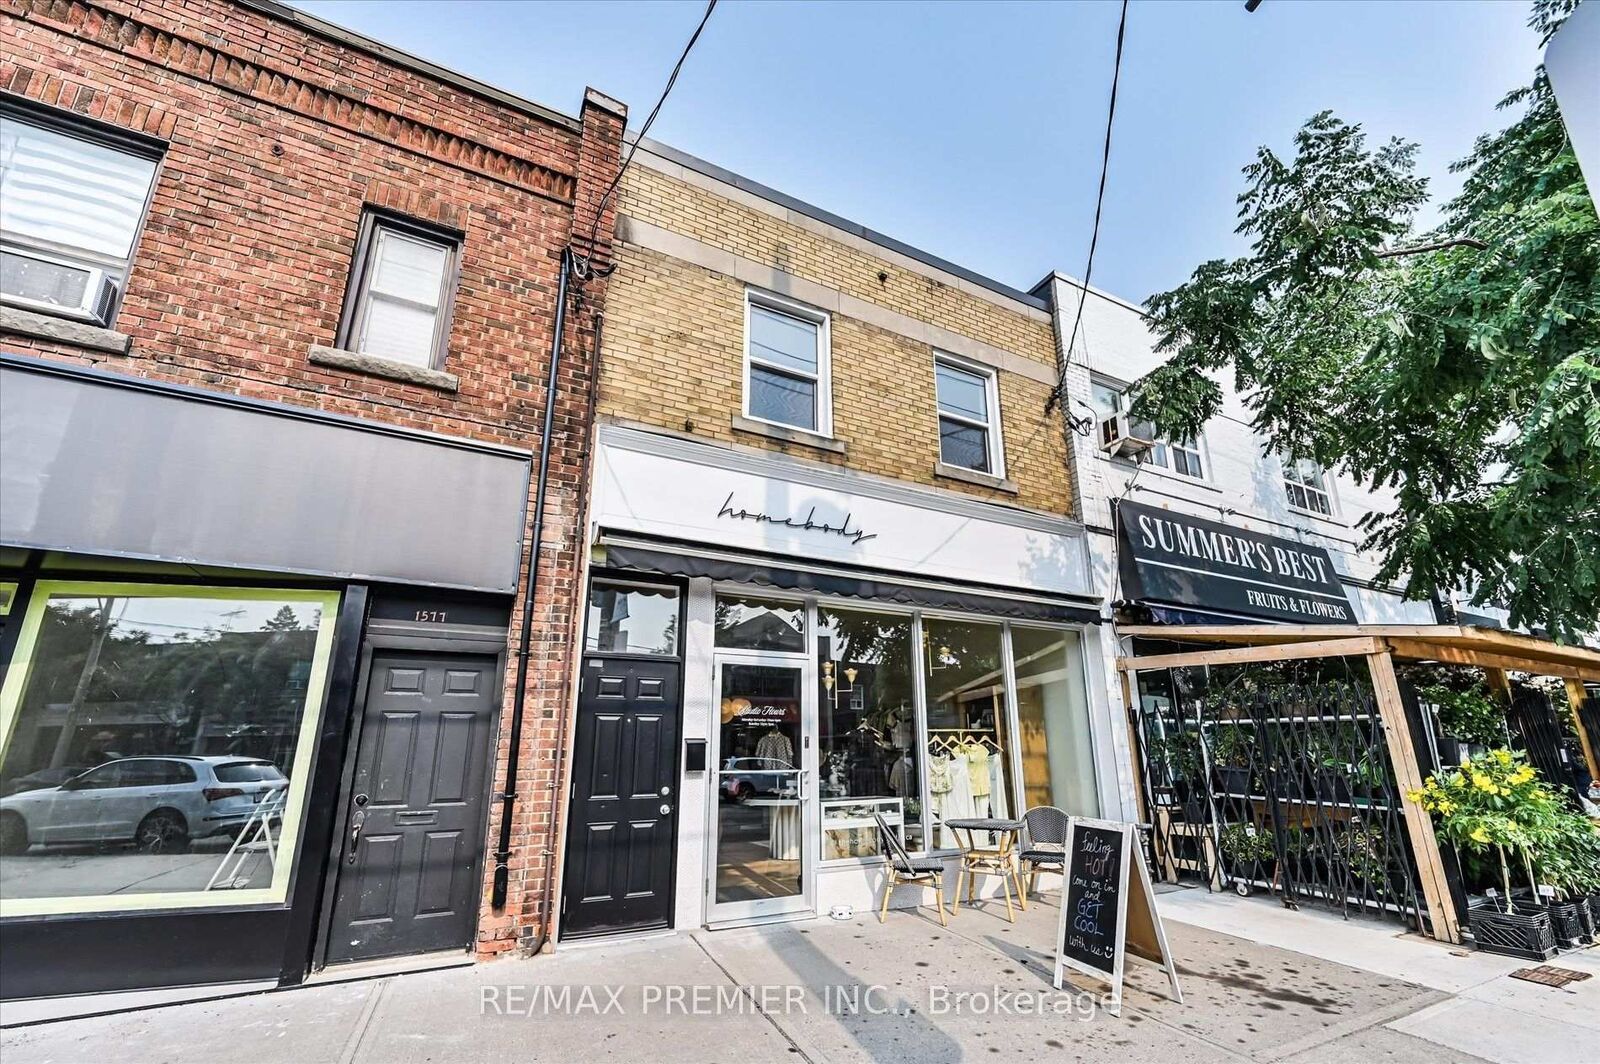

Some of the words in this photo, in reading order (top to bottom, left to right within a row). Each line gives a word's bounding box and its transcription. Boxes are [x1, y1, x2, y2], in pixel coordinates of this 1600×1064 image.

[717, 491, 878, 545] homebody
[1138, 514, 1273, 574] SUMMER'S
[1273, 546, 1328, 584] BEST
[1246, 589, 1288, 611] FRUITS
[1289, 597, 1299, 612] &
[1298, 599, 1348, 620] FLOWERS
[415, 610, 446, 623] 1577
[1080, 831, 1114, 862] feeling
[1084, 890, 1101, 903] and
[1091, 881, 1103, 890] on
[1103, 879, 1116, 893] in
[1077, 898, 1104, 920] GET
[1073, 915, 1104, 936] COOL
[1069, 935, 1089, 952] with
